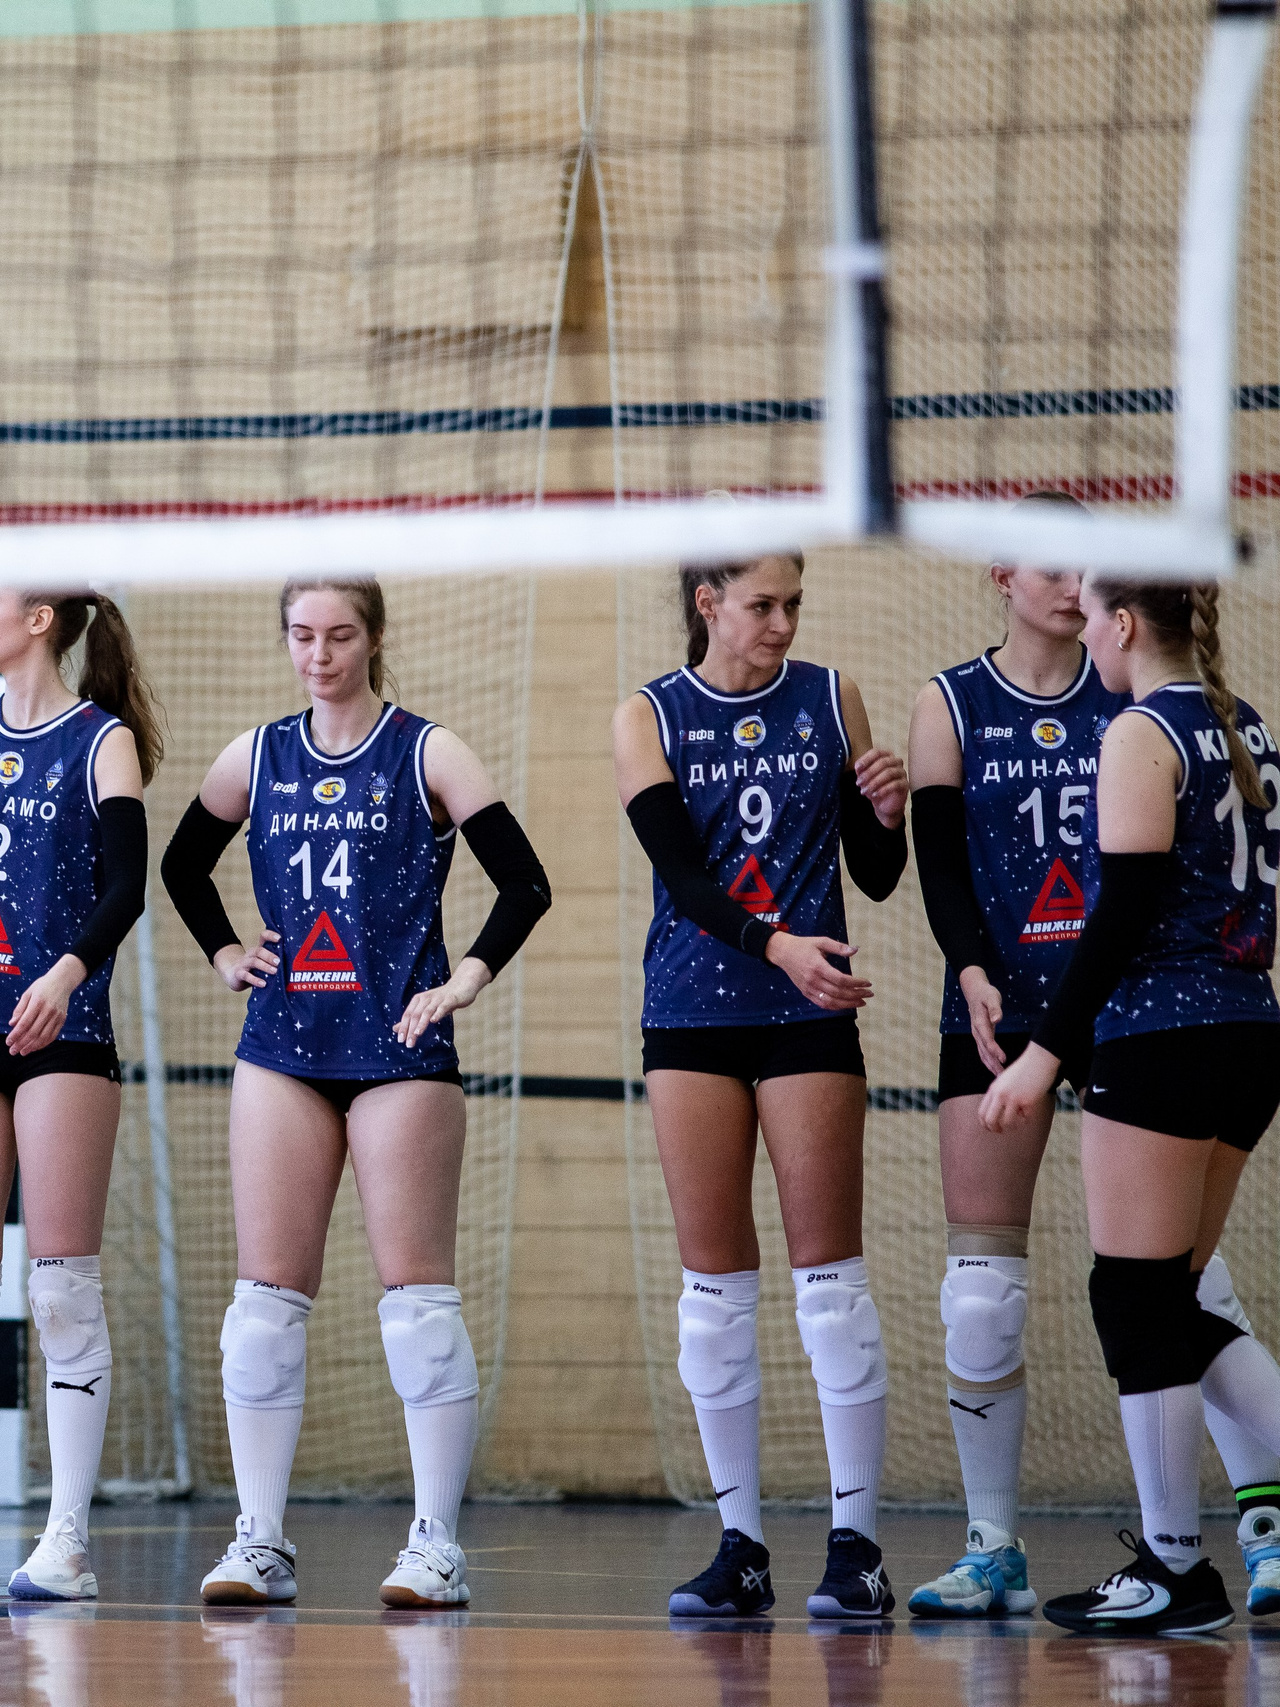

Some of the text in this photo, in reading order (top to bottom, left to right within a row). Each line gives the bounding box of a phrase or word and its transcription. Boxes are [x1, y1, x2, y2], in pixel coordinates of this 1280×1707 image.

[688, 729, 715, 741] ВФВ
[984, 726, 1013, 739] ВФВ
[688, 751, 818, 788] ДИНАМО
[982, 756, 1098, 784] ДИНАМ
[272, 781, 299, 794] ВФВ
[738, 785, 773, 845] 9
[1017, 784, 1090, 848] 15
[269, 810, 388, 838] ДИНАМО
[288, 839, 353, 901] 14
[1022, 919, 1085, 935] ДВИЖЕН
[1031, 932, 1082, 942] НЕФТЕПРО
[42, 1258, 65, 1267] asics
[965, 1259, 989, 1268] asics
[815, 1272, 839, 1283] asics
[700, 1285, 723, 1296] asics
